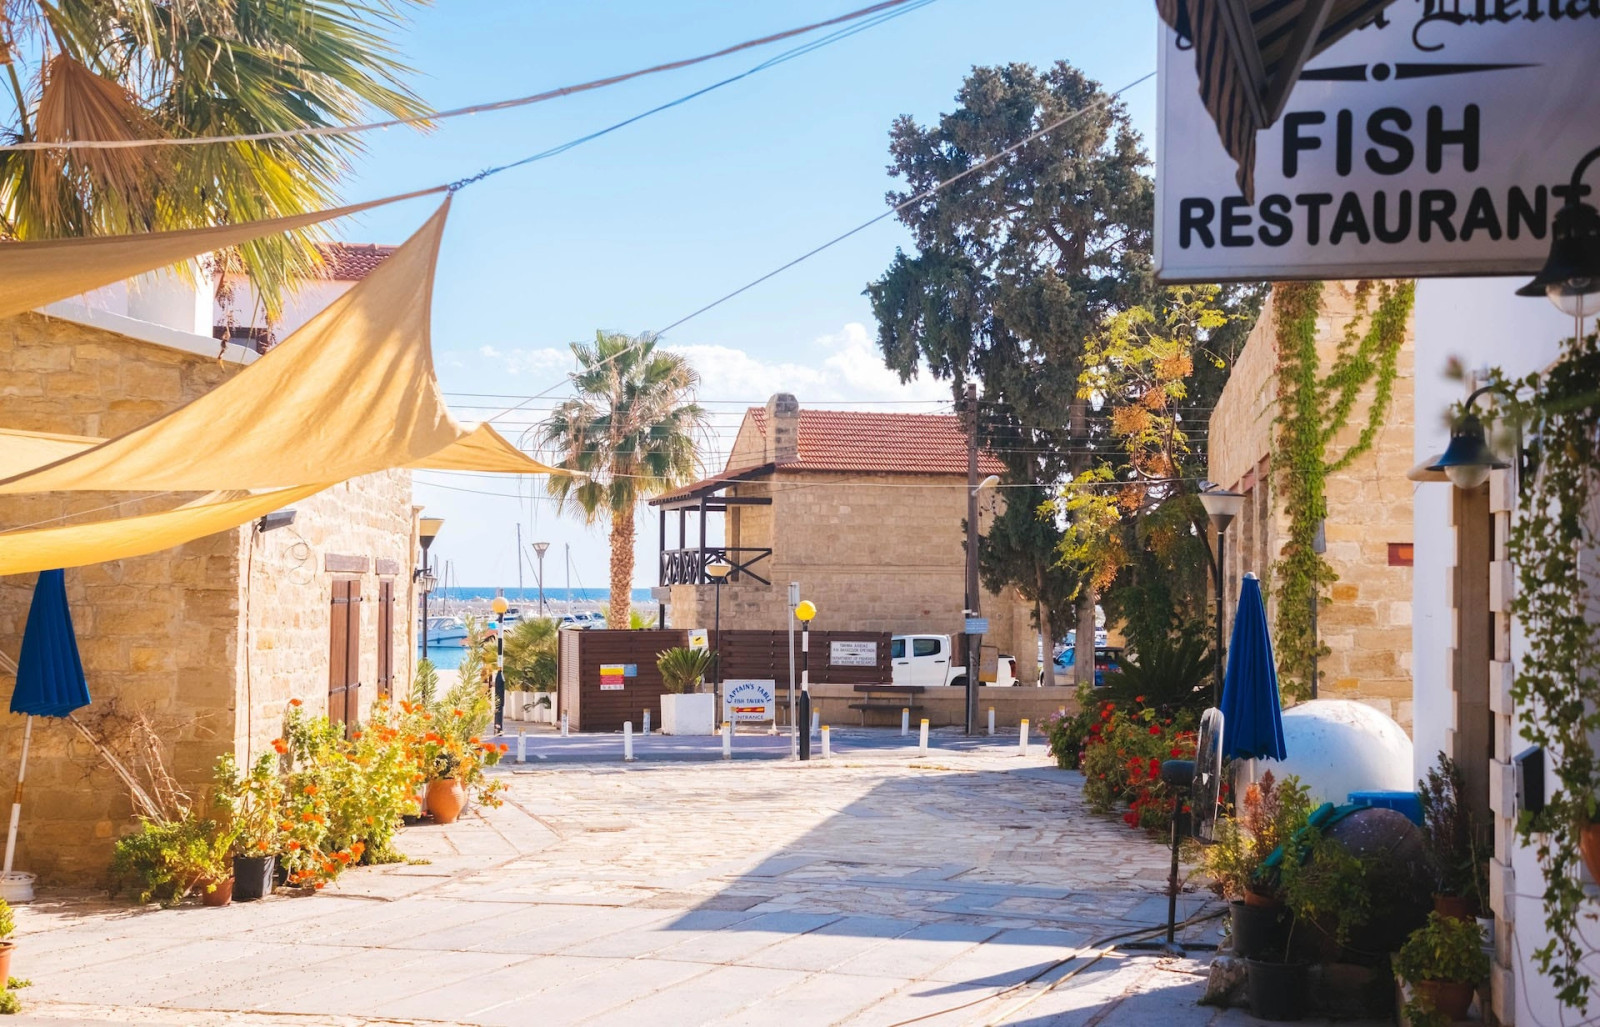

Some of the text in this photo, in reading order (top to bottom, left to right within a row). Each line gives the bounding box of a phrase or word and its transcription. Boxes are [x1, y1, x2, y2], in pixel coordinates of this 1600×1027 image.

[1283, 104, 1480, 178] FISH
[726, 683, 772, 704] CAPTAIN'S TABLE
